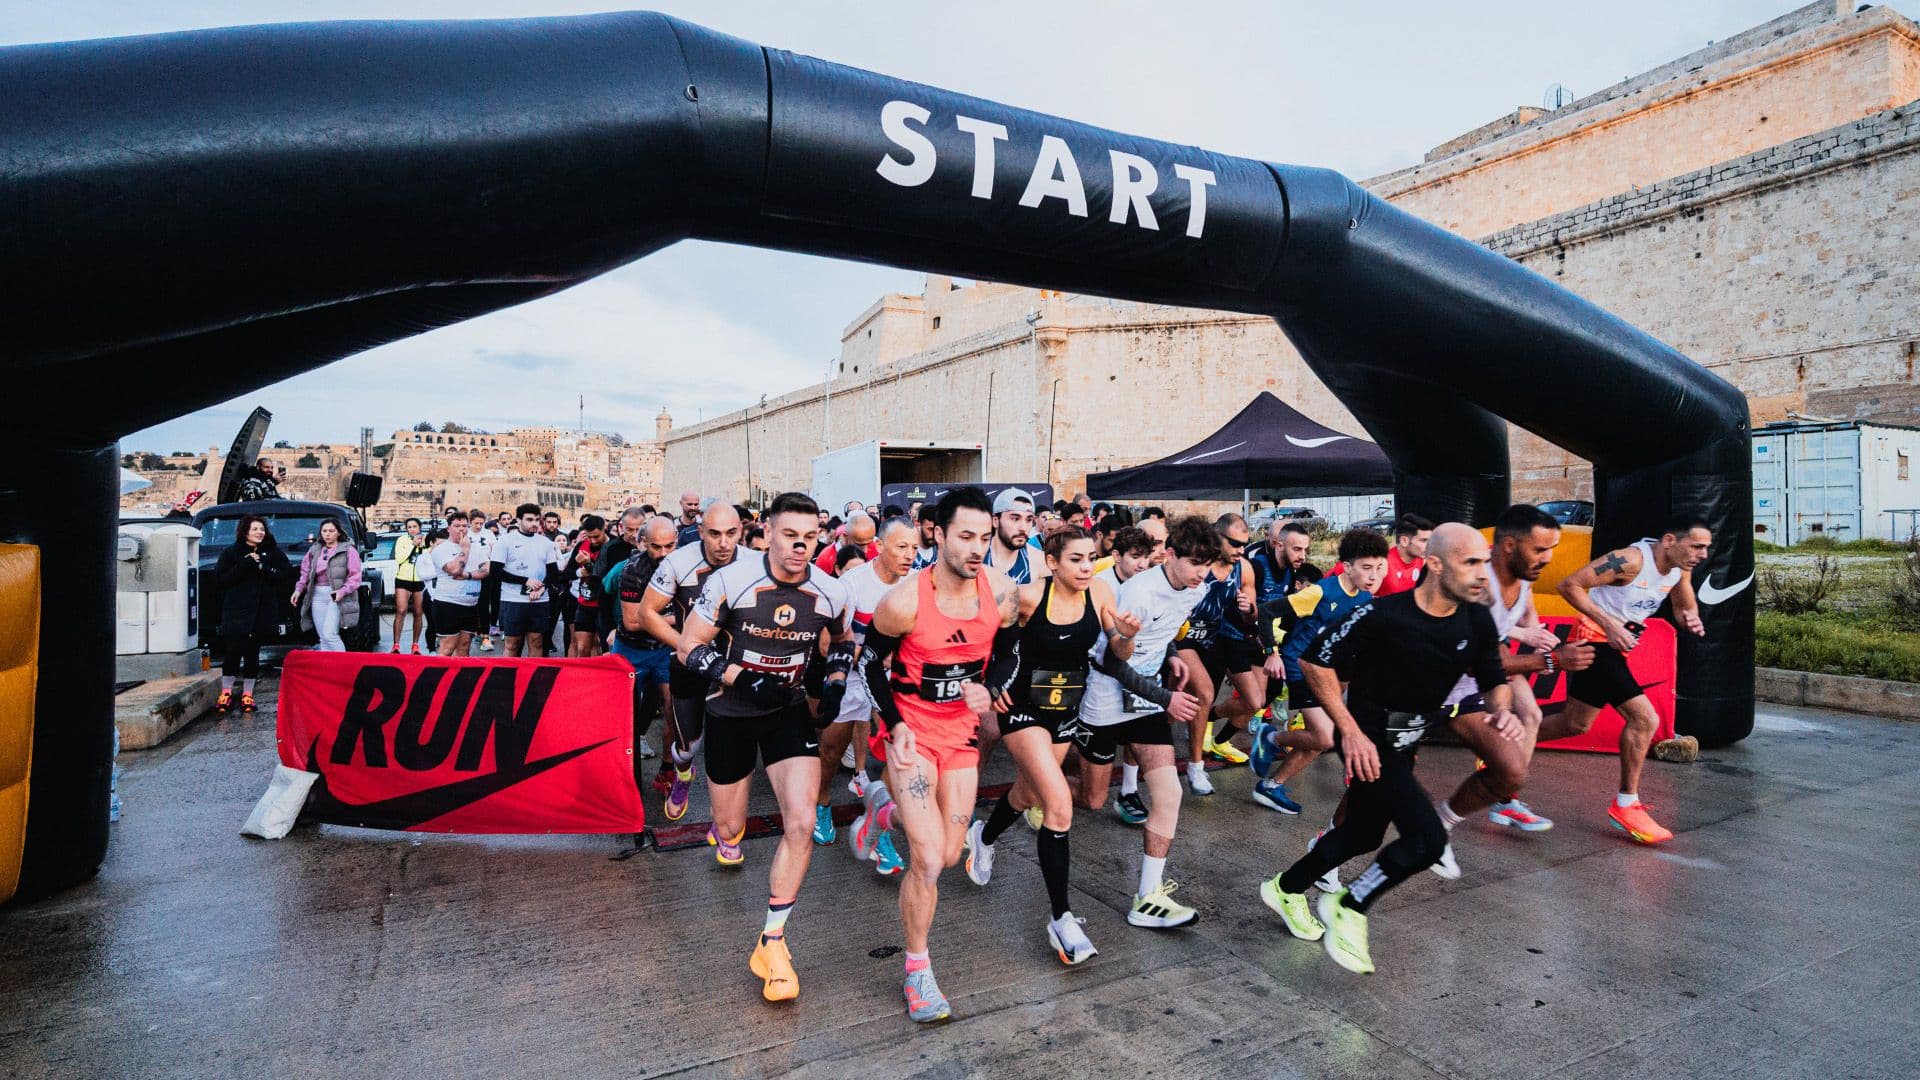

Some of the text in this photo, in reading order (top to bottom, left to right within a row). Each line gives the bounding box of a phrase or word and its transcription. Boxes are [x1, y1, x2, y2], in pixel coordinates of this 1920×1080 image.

[876, 100, 1217, 239] START
[741, 621, 817, 641] Heartcore+
[330, 665, 562, 774] RUN
[1049, 688, 1063, 705] 6
